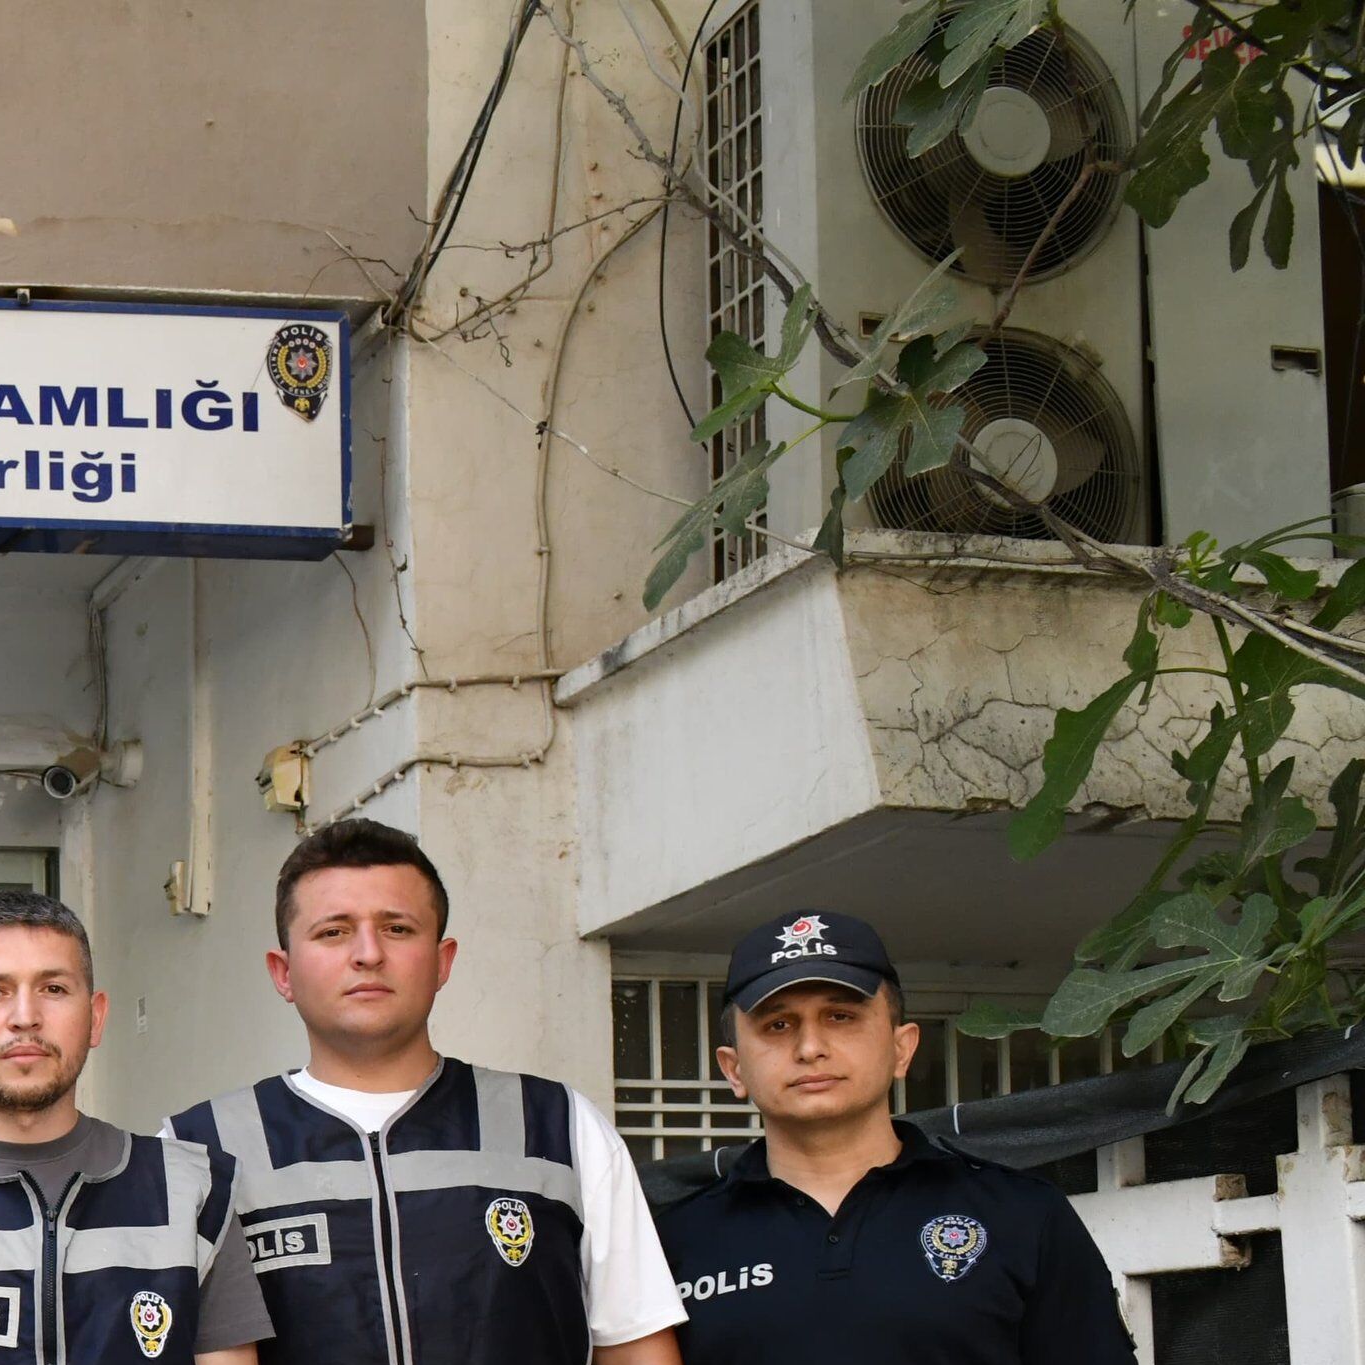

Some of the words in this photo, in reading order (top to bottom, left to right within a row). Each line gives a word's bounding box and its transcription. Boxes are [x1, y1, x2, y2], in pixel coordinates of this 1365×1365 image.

[281, 327, 323, 341] POLİS
[771, 942, 838, 964] POLİS
[495, 1201, 524, 1213] POLİS
[675, 1262, 774, 1301] POLİS
